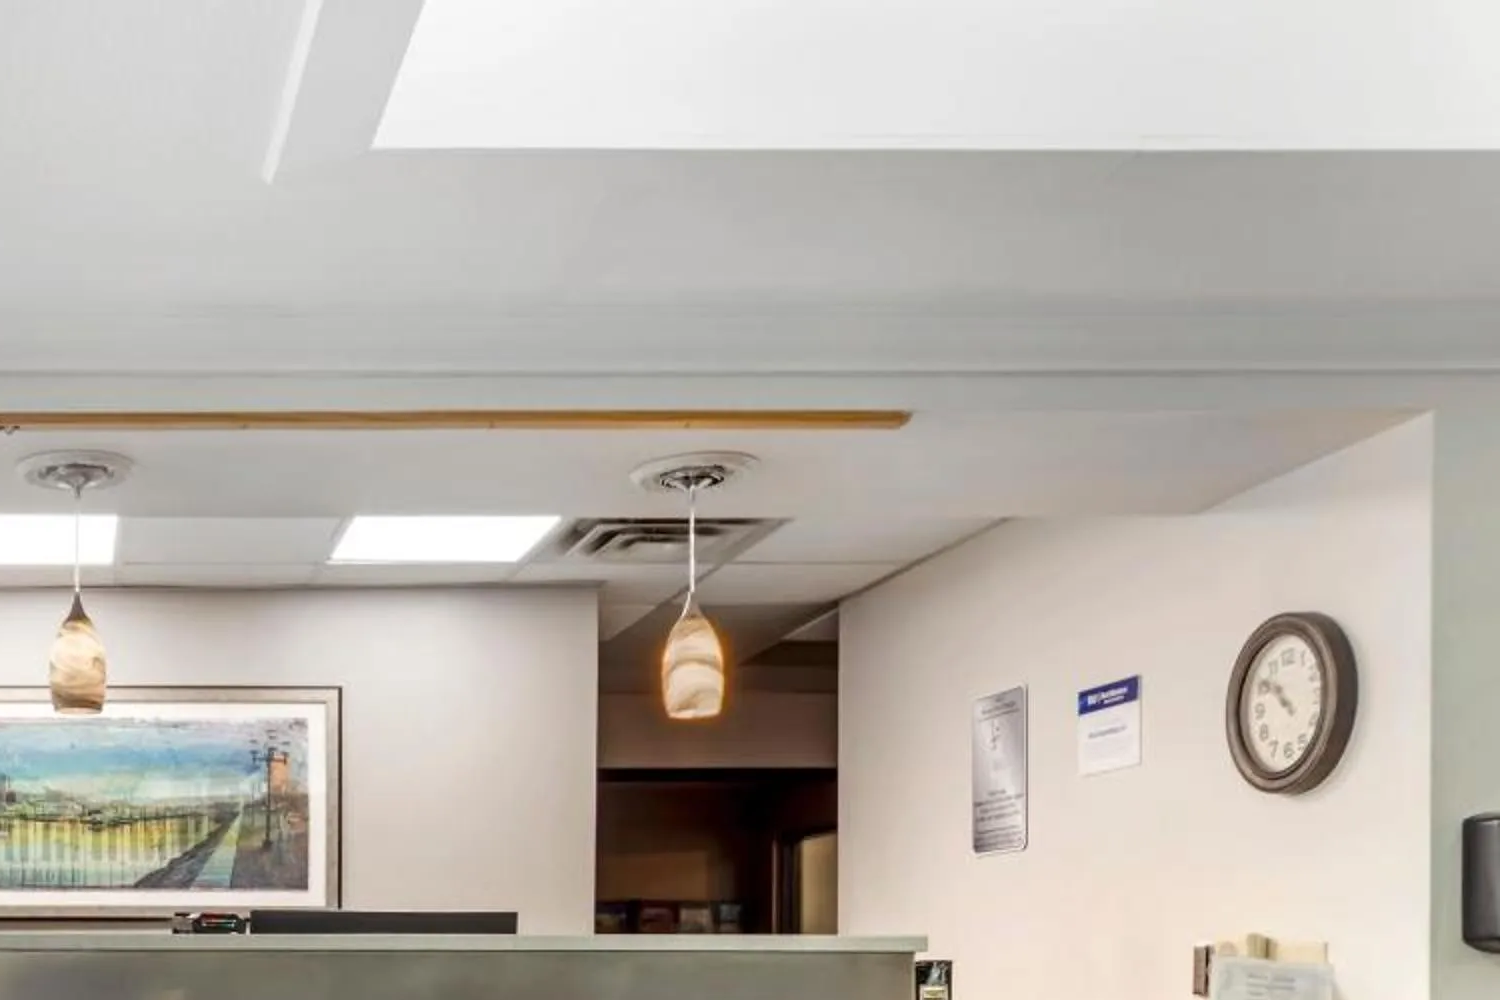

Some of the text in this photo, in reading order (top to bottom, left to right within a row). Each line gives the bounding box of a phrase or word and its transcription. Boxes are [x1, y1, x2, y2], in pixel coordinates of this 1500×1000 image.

[1280, 648, 1295, 666] 12
[1254, 703, 1265, 719] 9
[1259, 724, 1268, 741] 8
[1268, 740, 1278, 758] 7
[1283, 742, 1294, 759] 6
